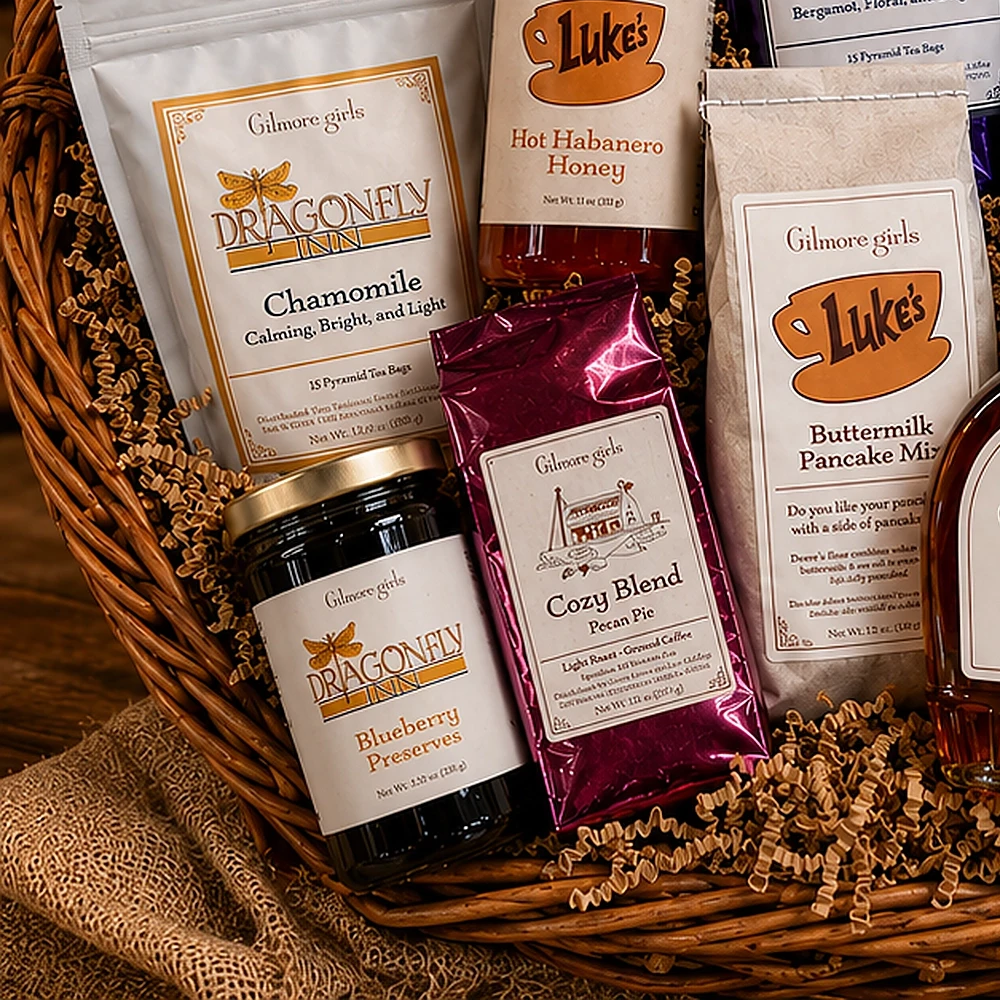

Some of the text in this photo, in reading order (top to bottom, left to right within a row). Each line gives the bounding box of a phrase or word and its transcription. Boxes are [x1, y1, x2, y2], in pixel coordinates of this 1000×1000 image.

[792, 2, 861, 21] Bergamot,
[248, 99, 365, 136] Gilmore girls
[511, 128, 664, 155] Hot Habanero
[547, 153, 626, 184] Honey
[211, 178, 432, 250] DRAGONFLY
[296, 227, 362, 261] INN
[786, 218, 920, 258] Gilmore girls
[263, 270, 422, 319] Chamomile
[244, 297, 447, 347] Calming, Bright, and Light
[808, 413, 934, 445] Buttermilk
[799, 448, 895, 473] Pancake
[787, 504, 806, 517] Do
[810, 505, 832, 519] you
[860, 500, 890, 514] your
[791, 522, 819, 535] with
[860, 516, 872, 529] of
[375, 570, 406, 600] girls
[546, 562, 683, 619] Cozy Blend
[588, 613, 630, 635] Pecan
[306, 622, 464, 704] DRAGONFLY
[365, 670, 420, 706] INN
[354, 707, 461, 752] Blueberry
[366, 730, 462, 773] Preserves
